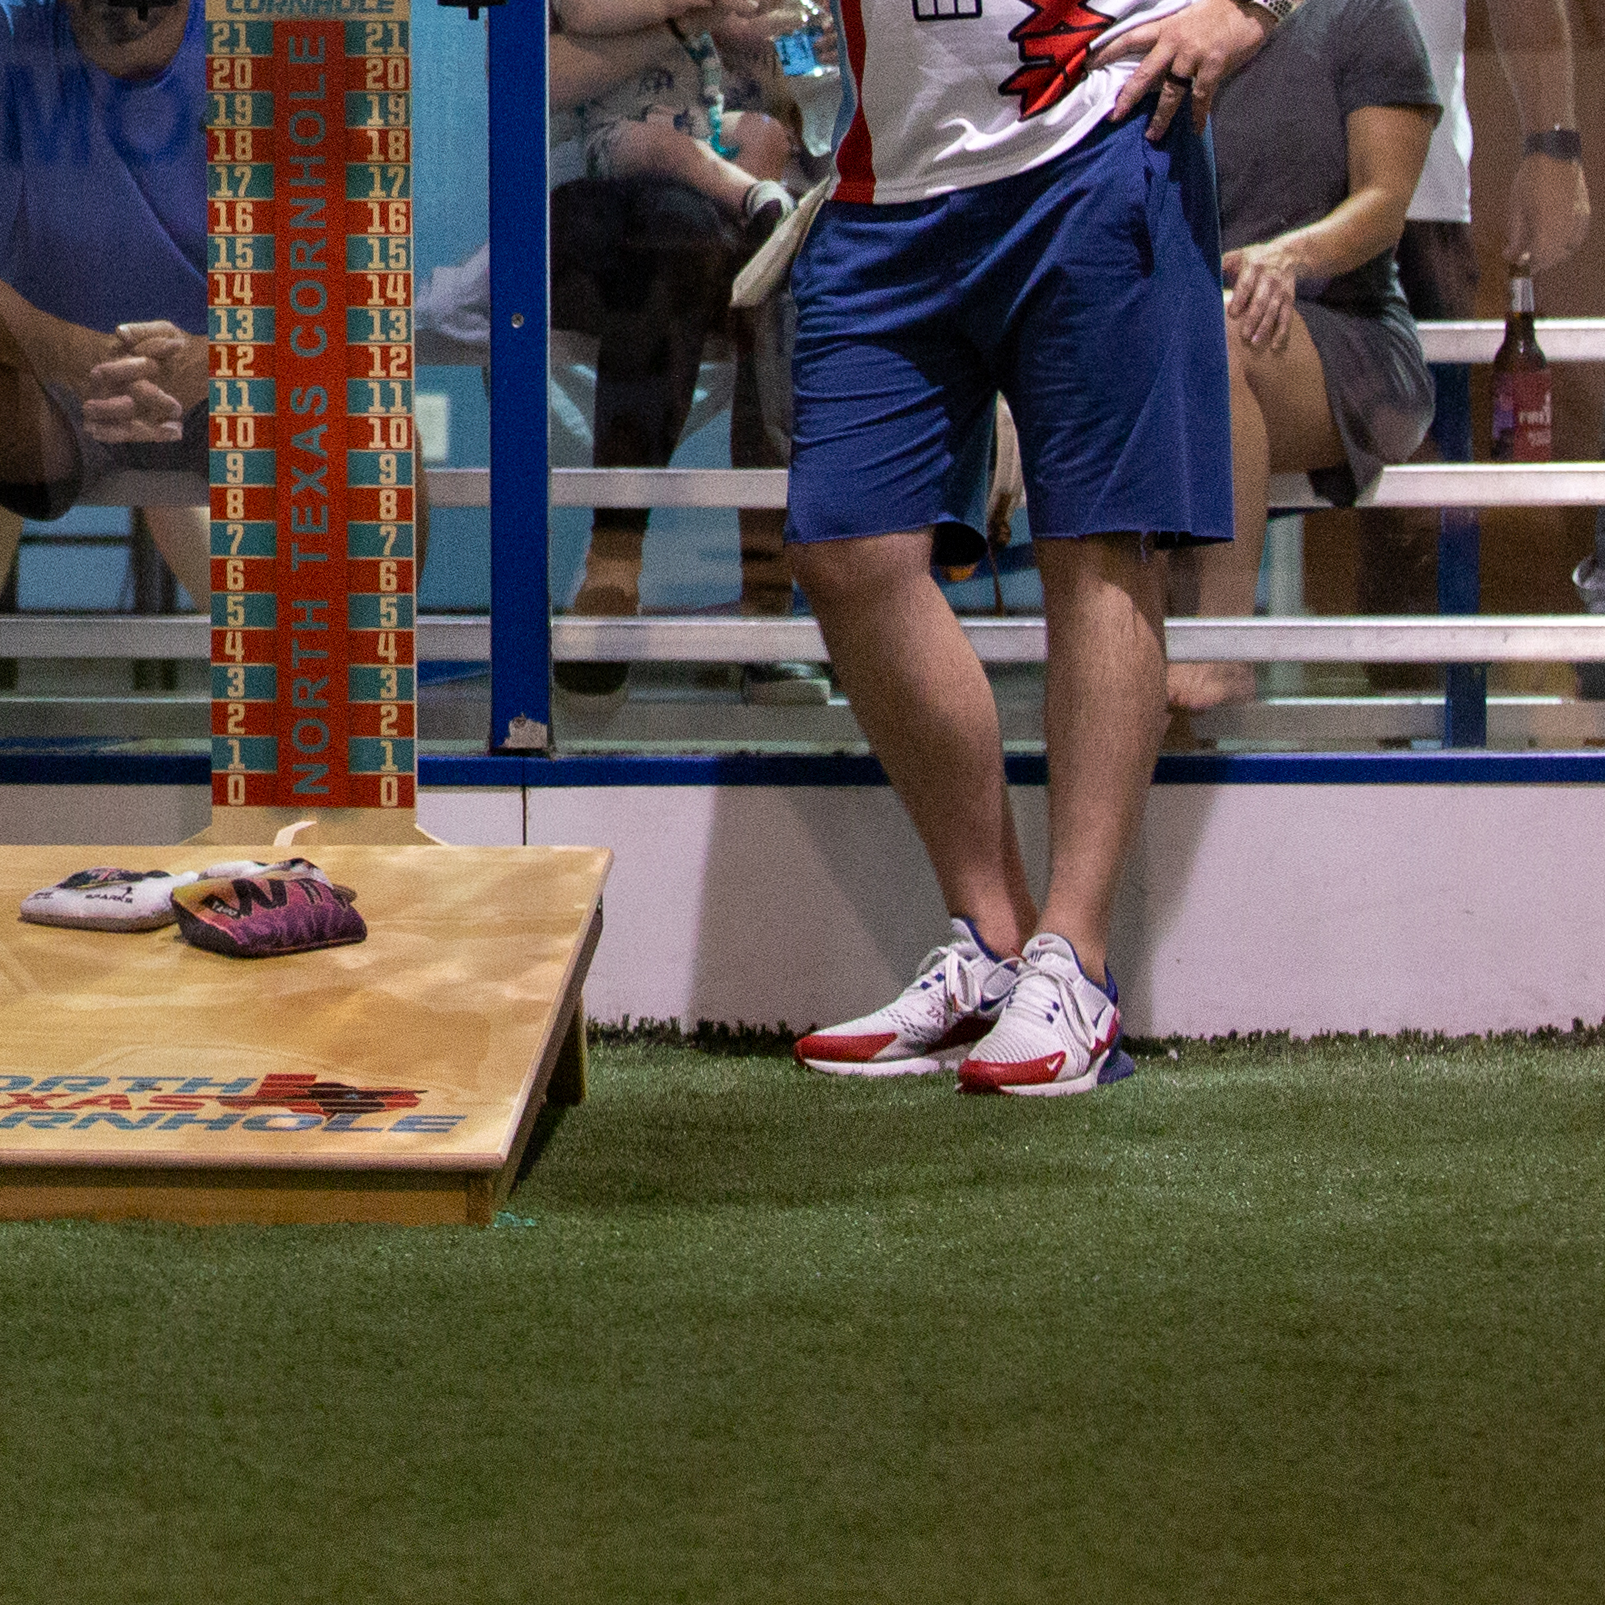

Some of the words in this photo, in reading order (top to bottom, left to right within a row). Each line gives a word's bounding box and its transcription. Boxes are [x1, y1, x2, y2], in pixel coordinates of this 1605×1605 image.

[212, 23, 249, 53] 21
[365, 23, 403, 53] 21
[212, 59, 252, 89] 20
[366, 59, 406, 89] 20
[213, 94, 252, 126] 19
[366, 94, 406, 126] 19
[213, 130, 253, 161] 18
[367, 130, 406, 161] 18
[213, 166, 253, 197] 17
[288, 36, 328, 358] CORNHOLE
[367, 166, 406, 197] 17
[214, 202, 253, 232] 16
[367, 202, 406, 232] 16
[214, 238, 253, 269] 15
[367, 238, 407, 269] 15
[214, 274, 254, 305] 14
[368, 274, 407, 305] 14
[215, 310, 254, 340] 13
[368, 311, 407, 341] 13
[215, 345, 254, 376] 12
[369, 346, 407, 377] 12
[215, 381, 254, 413] 11
[369, 382, 407, 414] 11
[215, 417, 254, 447] 10
[369, 418, 407, 448] 10
[227, 453, 245, 484] 9
[291, 385, 328, 572] TEXAS
[380, 454, 398, 485] 9
[227, 488, 245, 519] 8
[380, 489, 398, 520] 8
[227, 524, 245, 555] 7
[380, 525, 398, 556] 7
[227, 560, 245, 590] 6
[380, 561, 398, 591] 6
[227, 596, 245, 627] 5
[380, 597, 398, 628] 5
[225, 631, 245, 662] 4
[378, 632, 398, 663] 4
[227, 667, 245, 697] 3
[292, 600, 330, 794] NORTH
[380, 668, 398, 698] 3
[227, 703, 245, 734] 2
[380, 704, 398, 735] 2
[227, 739, 245, 770] 1
[380, 740, 398, 771] 1
[227, 775, 245, 806] 0
[381, 776, 398, 807] 0
